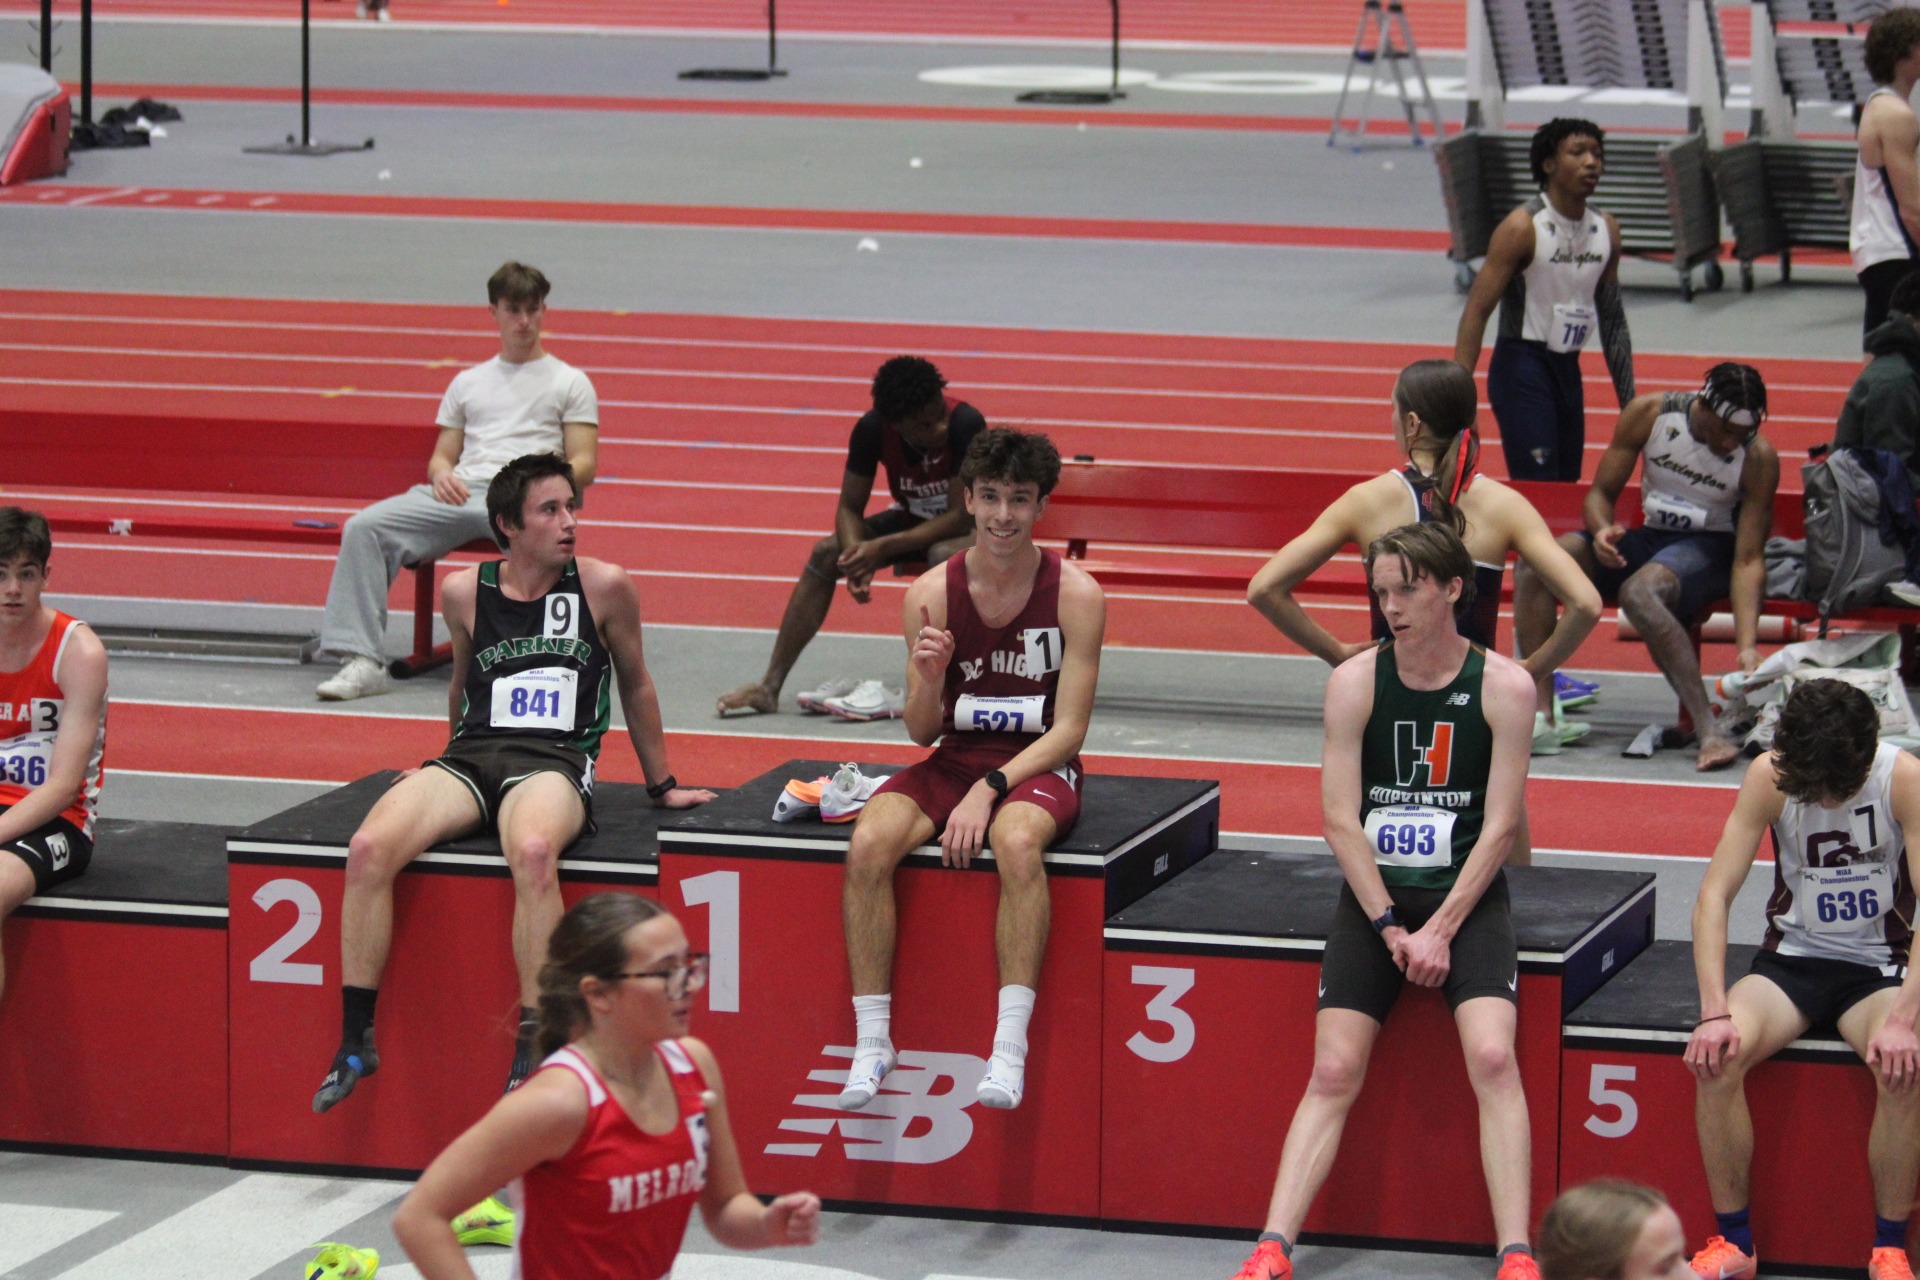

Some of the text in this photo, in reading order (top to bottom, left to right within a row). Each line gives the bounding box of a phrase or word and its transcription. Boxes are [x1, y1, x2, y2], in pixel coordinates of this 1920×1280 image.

[1648, 453, 1727, 491] Lexington
[550, 595, 571, 636] 9
[476, 634, 592, 672] PARKER
[1035, 631, 1053, 671] 1
[39, 701, 59, 732] 3
[510, 687, 560, 718] 841
[972, 710, 1025, 732] 527
[1368, 785, 1472, 807] HOPKINTON
[1377, 824, 1436, 856] 693
[1854, 804, 1878, 848] 7
[1820, 875, 1870, 885] Championships
[1816, 888, 1880, 923] 636
[249, 878, 323, 986] 2
[679, 870, 740, 1012] 1
[1125, 965, 1196, 1063] 3
[1583, 1063, 1639, 1138] 5
